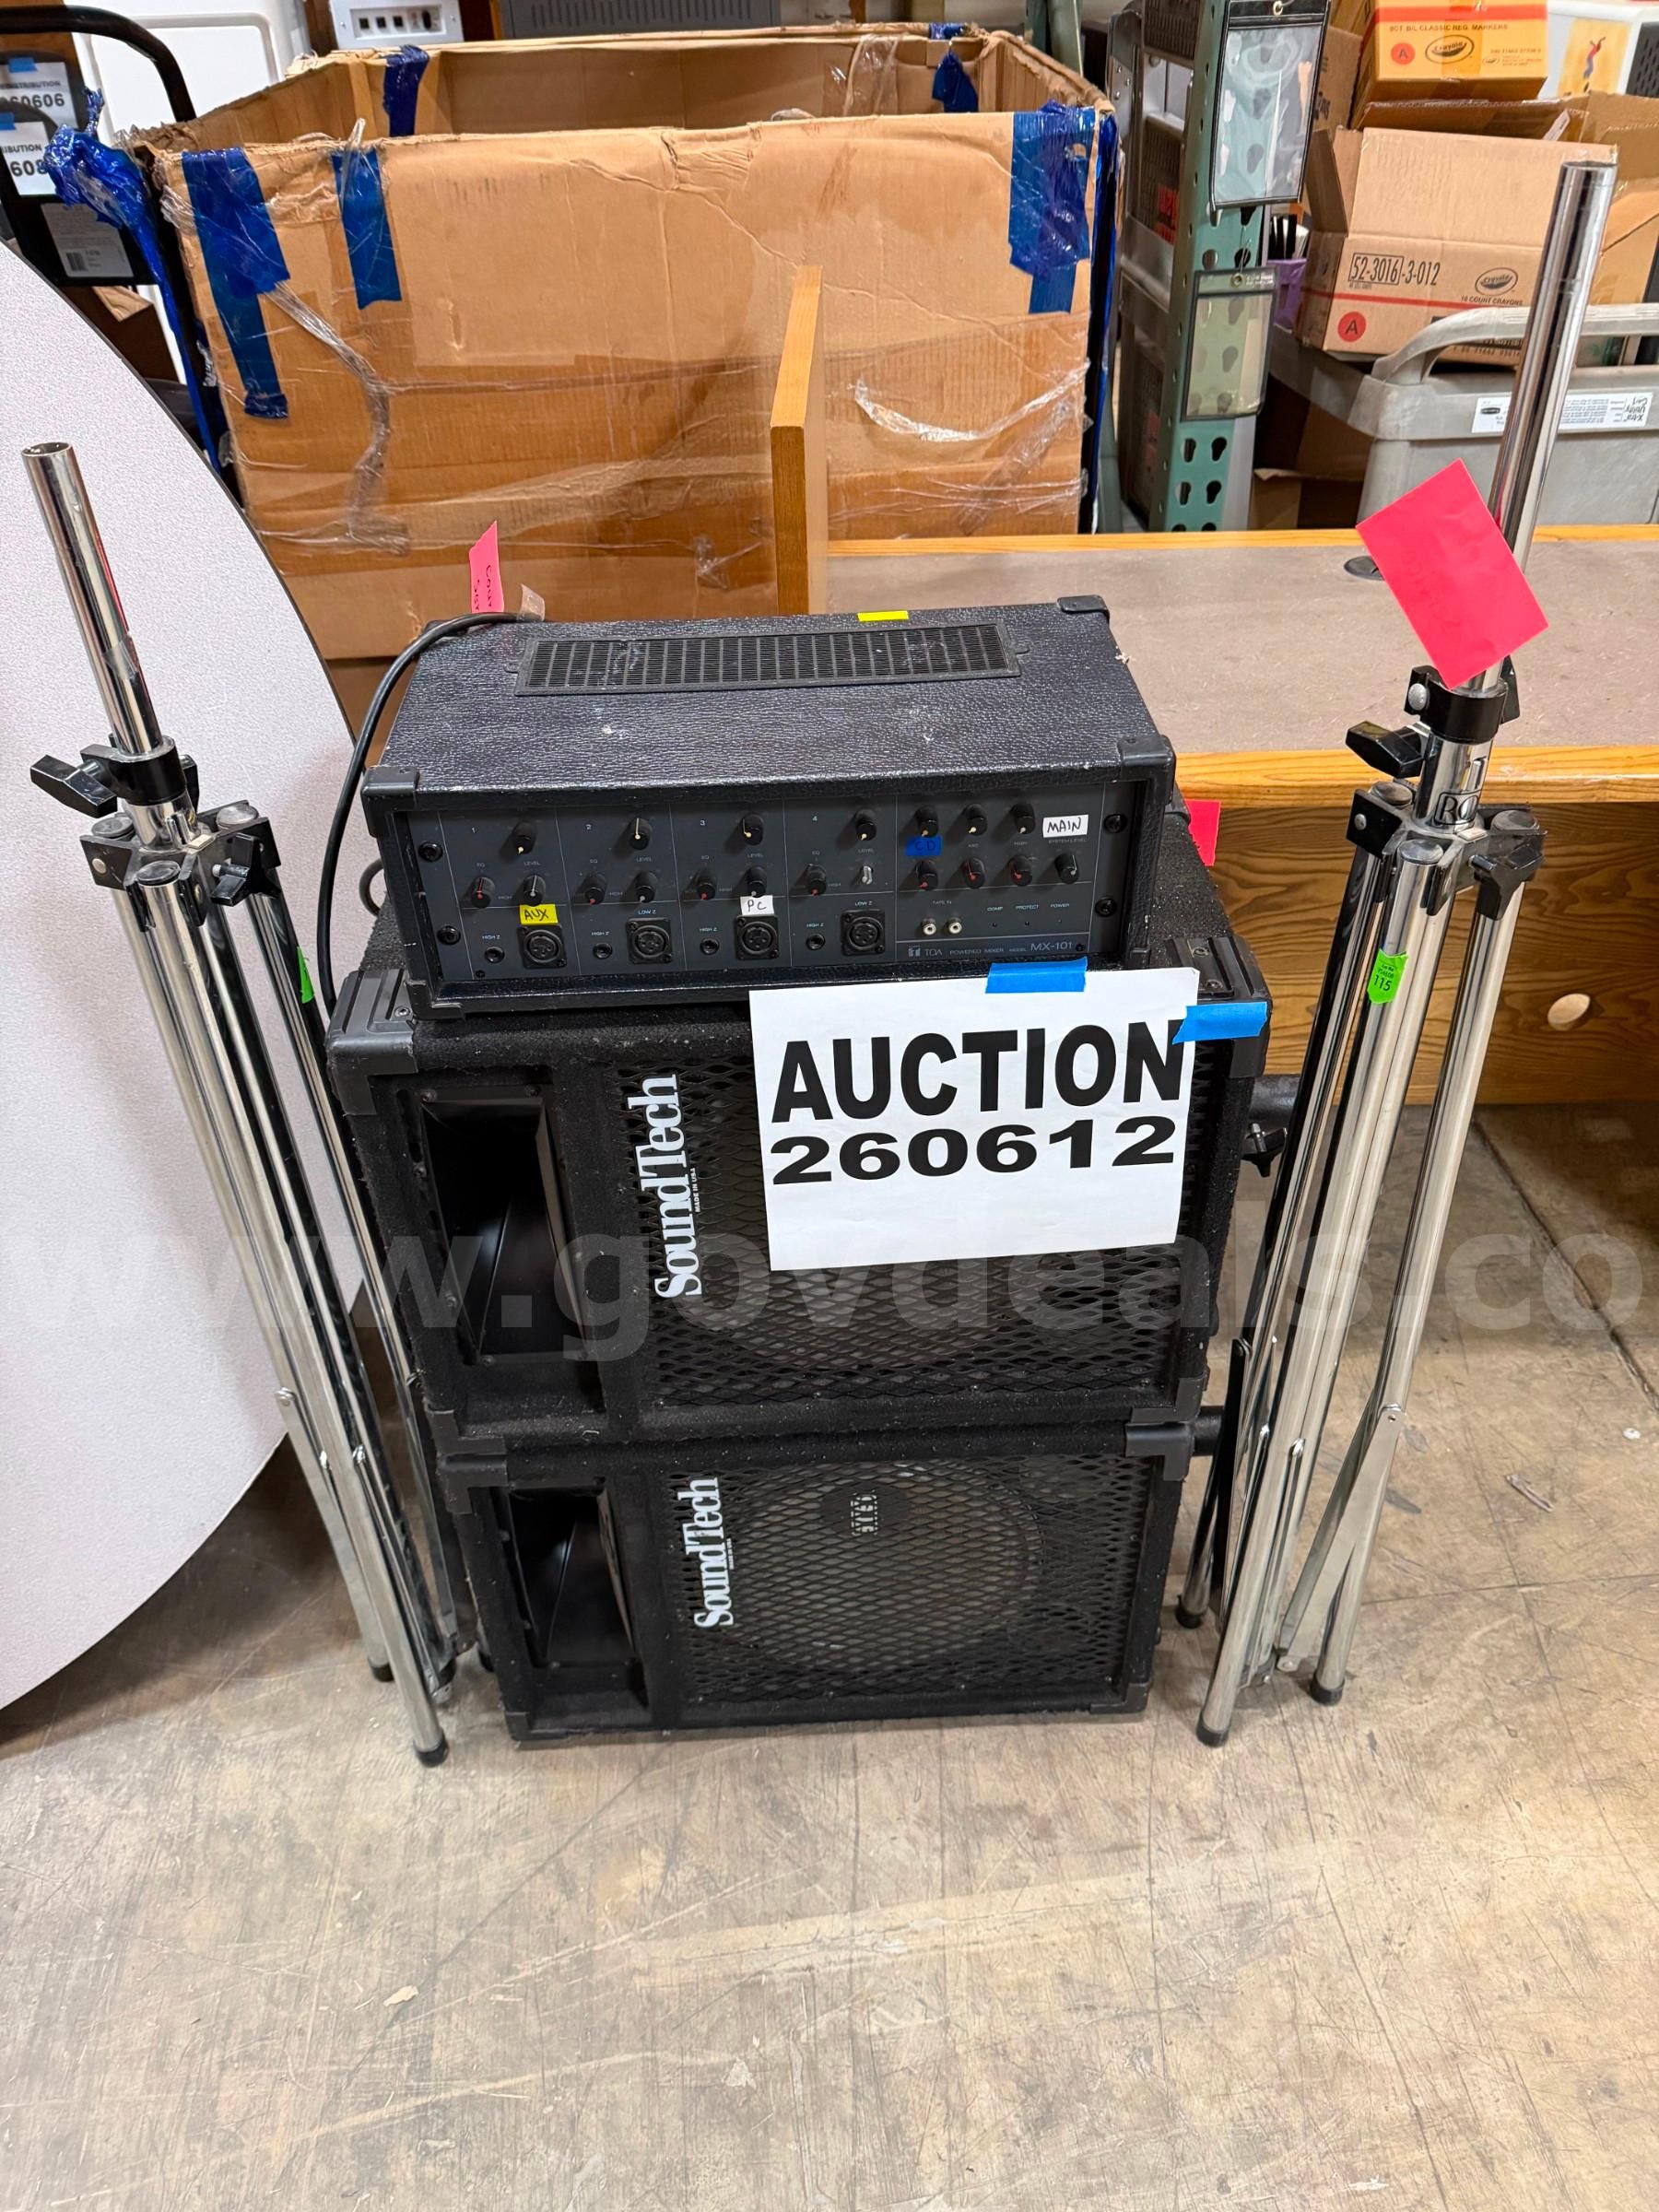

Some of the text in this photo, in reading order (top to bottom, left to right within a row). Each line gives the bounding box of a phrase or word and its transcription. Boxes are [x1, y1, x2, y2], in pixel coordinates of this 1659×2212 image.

[1398, 49, 1408, 60] A
[0, 93, 65, 109] 60606
[1350, 256, 1441, 286] 52-3016-3-012
[1345, 320, 1359, 335] A
[1047, 816, 1082, 834] MAIN
[747, 899, 767, 912] PC
[524, 909, 549, 921] AUX
[924, 948, 943, 957] TOA
[1030, 941, 1073, 952] MX-101
[1373, 974, 1393, 992] 115
[771, 1019, 1184, 1124] AUCTION
[771, 1115, 1176, 1185] 260612
[627, 1074, 702, 1299] SoundTech
[692, 1182, 699, 1192] IN
[677, 1477, 735, 1628] SoundTech
